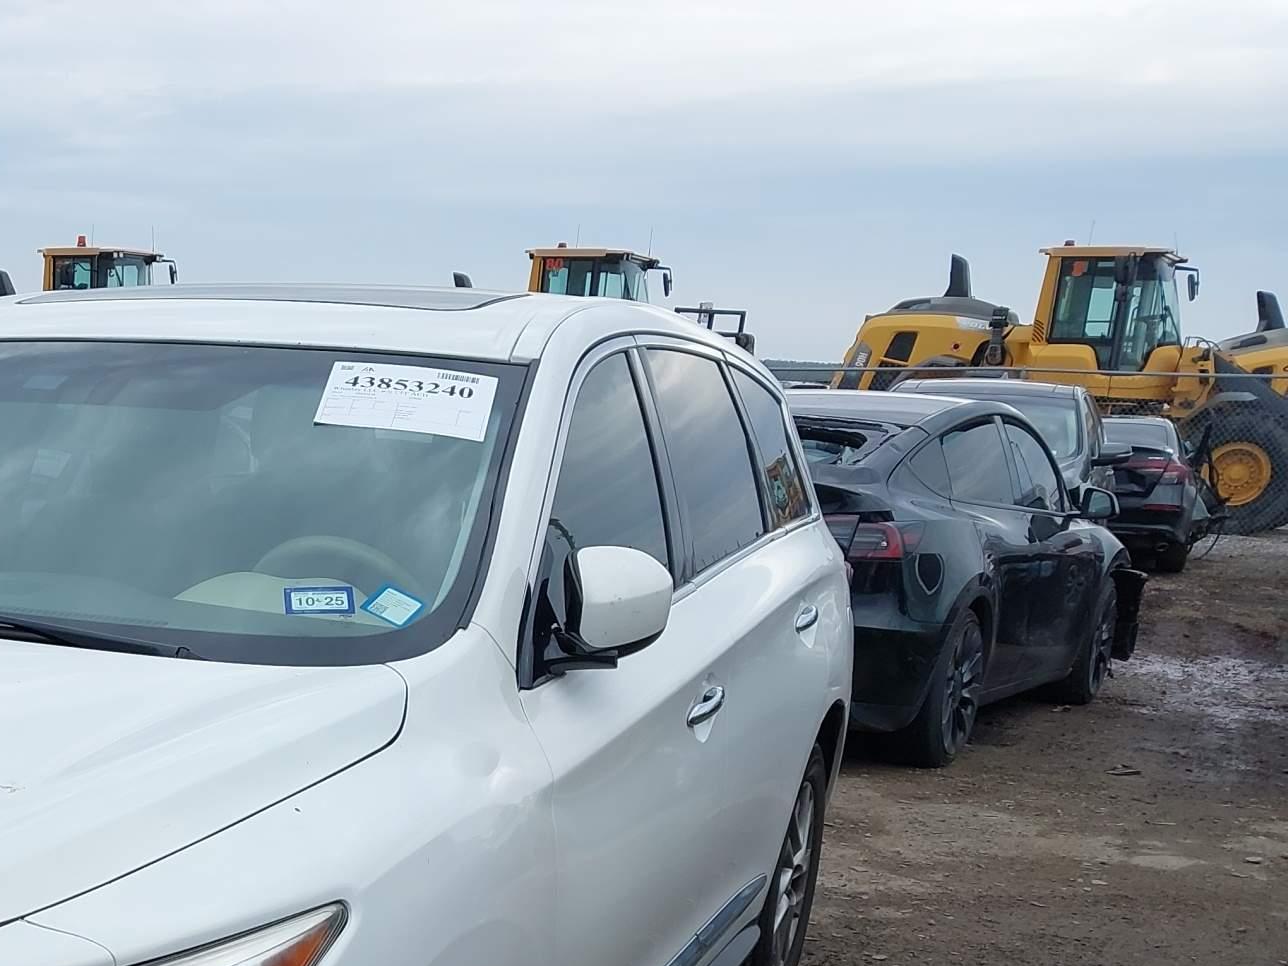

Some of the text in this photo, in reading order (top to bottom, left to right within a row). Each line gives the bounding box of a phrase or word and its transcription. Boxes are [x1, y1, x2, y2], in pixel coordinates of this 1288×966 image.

[344, 375, 474, 399] 43853240
[295, 596, 345, 607] 10 25
